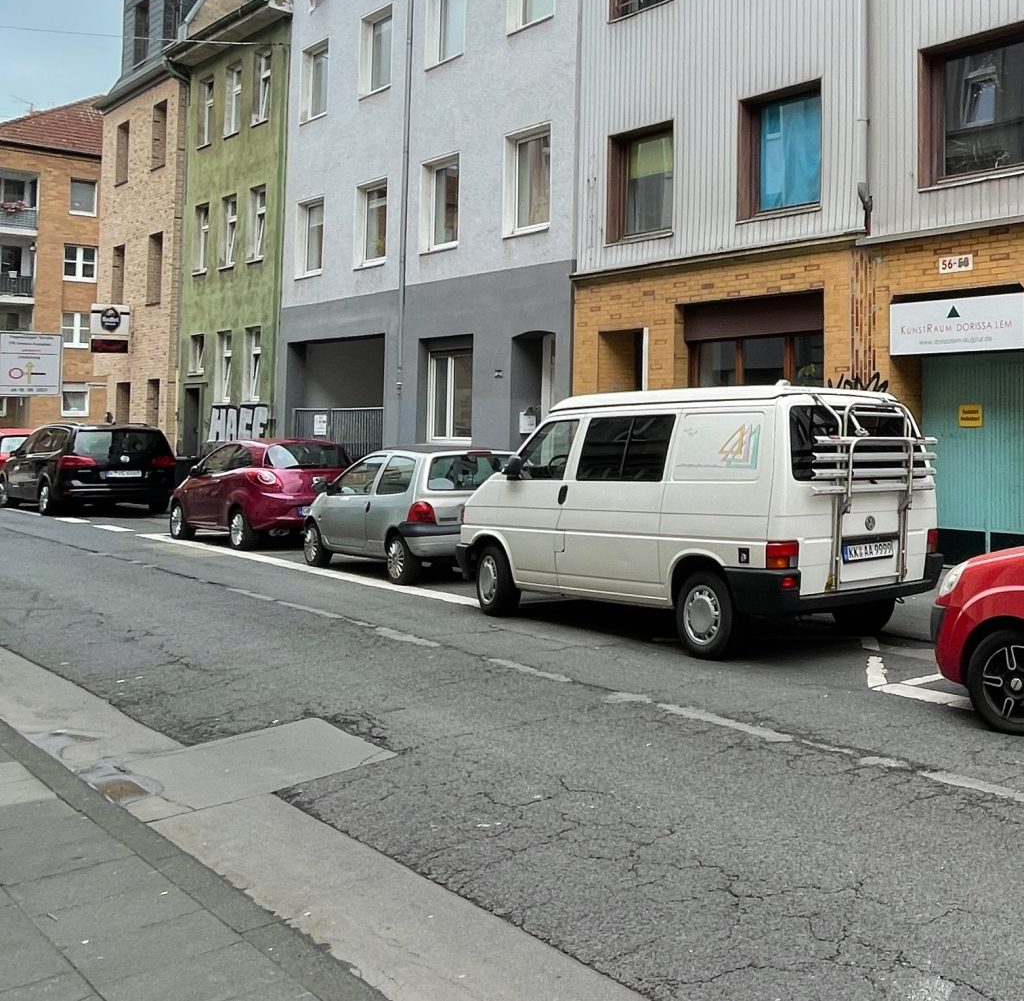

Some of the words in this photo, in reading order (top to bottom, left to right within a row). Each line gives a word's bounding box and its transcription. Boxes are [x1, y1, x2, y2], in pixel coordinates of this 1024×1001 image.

[956, 321, 992, 331] DORISSA
[995, 320, 1013, 329] LEM
[864, 546, 873, 556] AA
